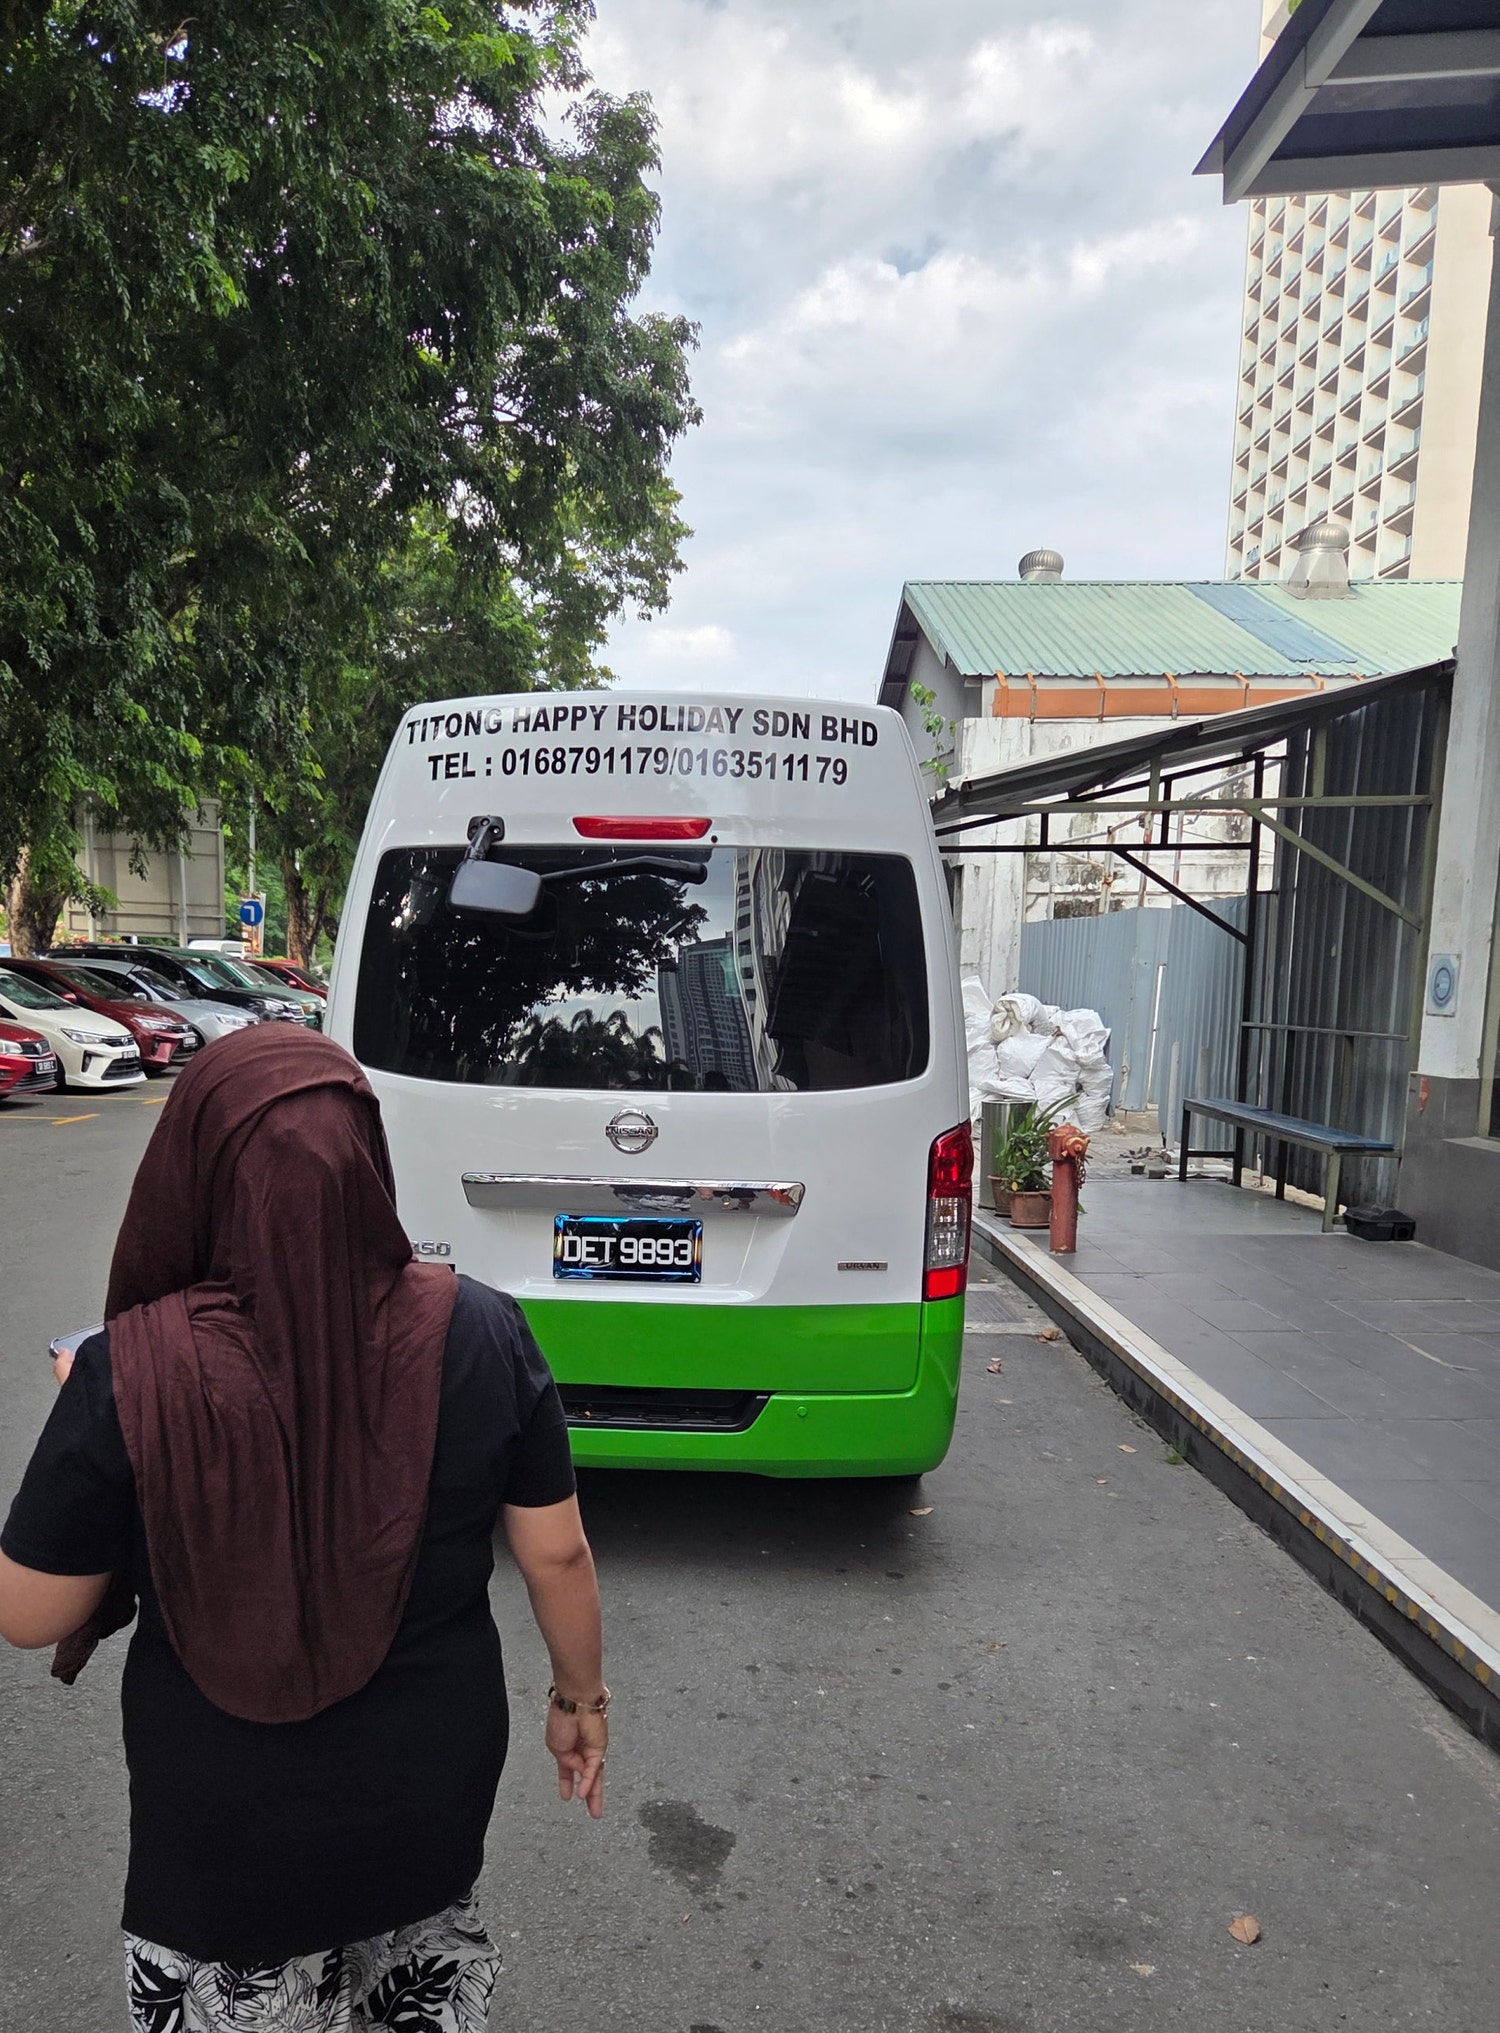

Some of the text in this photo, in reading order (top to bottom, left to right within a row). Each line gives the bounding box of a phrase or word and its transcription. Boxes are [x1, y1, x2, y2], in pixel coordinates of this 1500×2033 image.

[407, 705, 878, 747] TITONG HAPPY HOLIDAY SDN BHD
[428, 752, 475, 780] TEL
[501, 746, 848, 786] 0168791179/0163511179
[611, 1126, 653, 1136] NISSAN
[563, 1236, 692, 1265] DET 9893
